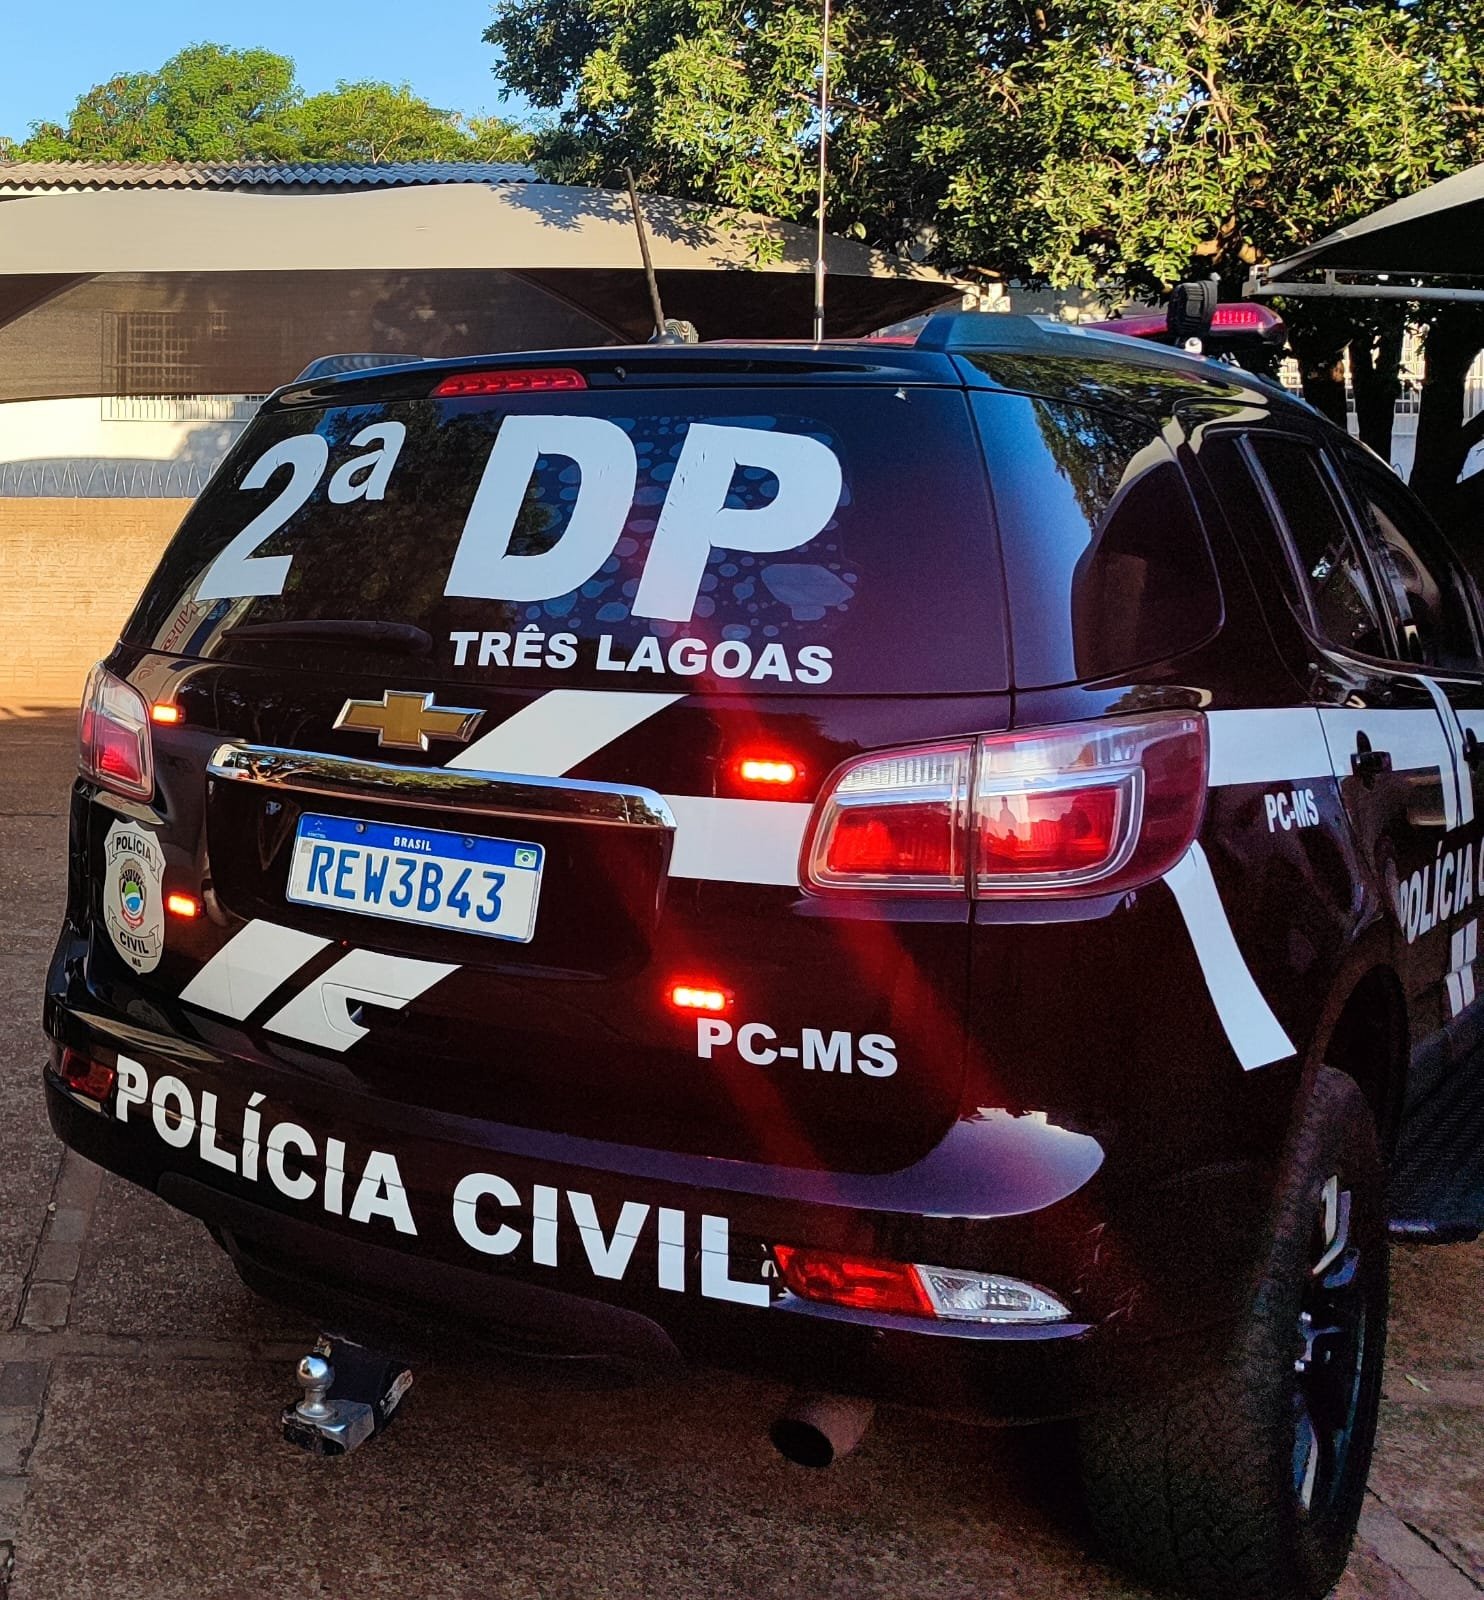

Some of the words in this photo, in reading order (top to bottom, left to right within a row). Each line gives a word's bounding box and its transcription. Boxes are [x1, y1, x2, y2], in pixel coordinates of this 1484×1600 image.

[444, 415, 843, 622] DP
[450, 624, 577, 669] TRÊS
[596, 634, 833, 684] LAGOAS
[1264, 788, 1320, 833] PC-MS
[116, 834, 152, 860] POLÍCIA
[393, 836, 432, 851] BRASIL
[307, 845, 505, 923] REW3B43
[1399, 840, 1473, 944] POLÍCIA
[119, 932, 149, 954] CIVIL
[131, 956, 142, 968] MS
[697, 1018, 898, 1078] PC-MS
[116, 1055, 418, 1236] POLÍCIA
[452, 1172, 770, 1308] CIVIL
